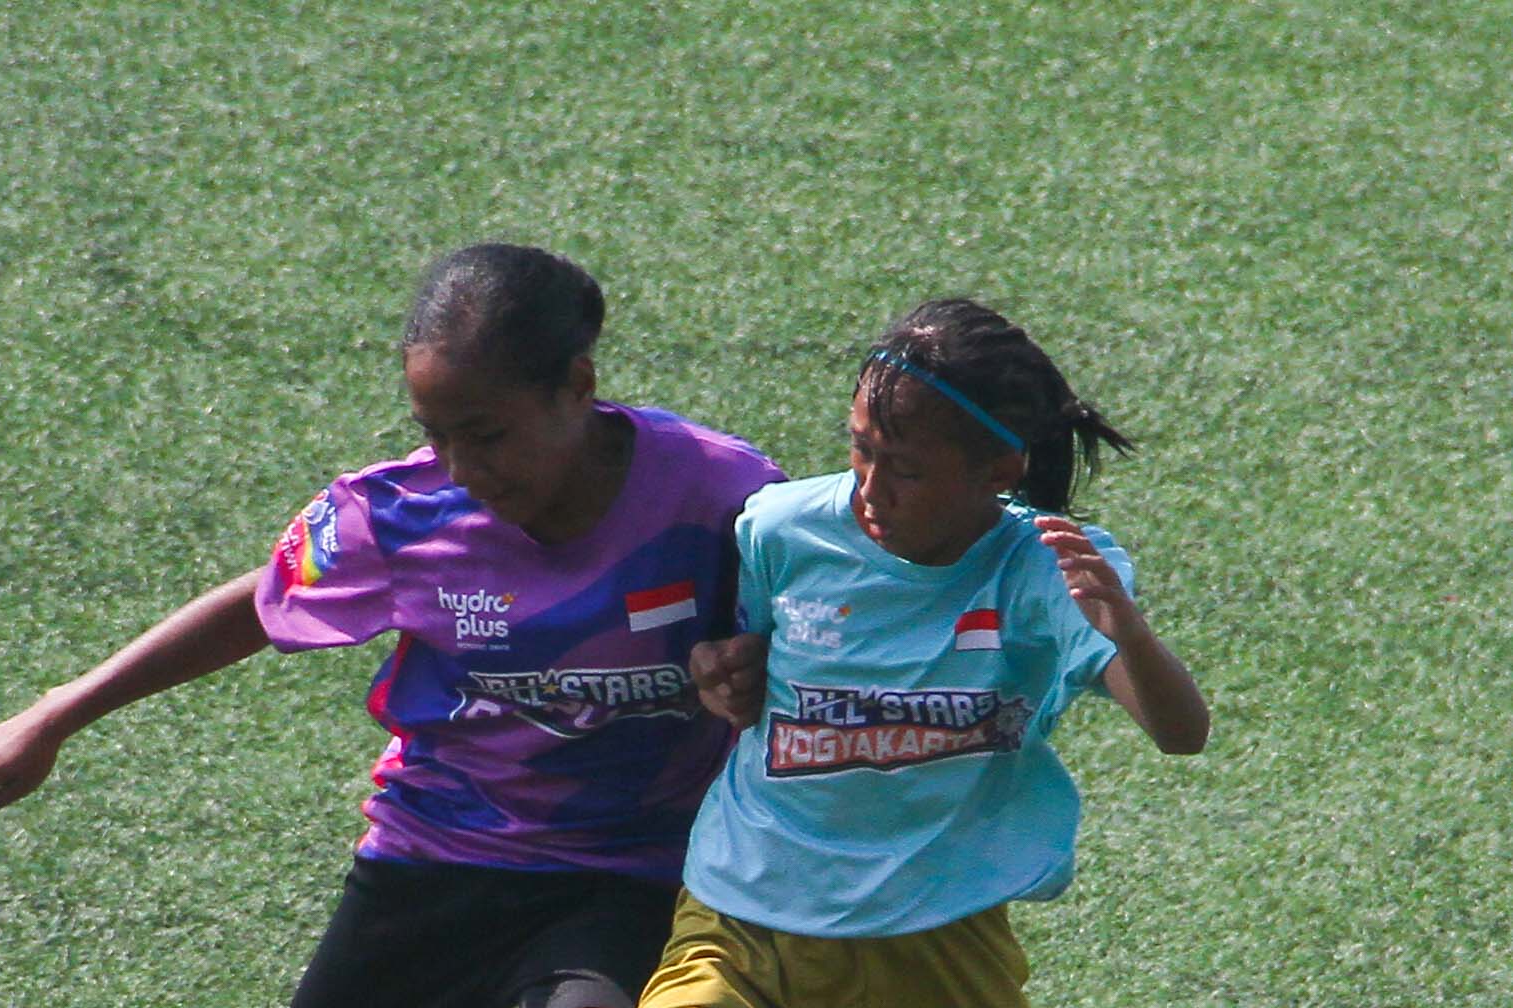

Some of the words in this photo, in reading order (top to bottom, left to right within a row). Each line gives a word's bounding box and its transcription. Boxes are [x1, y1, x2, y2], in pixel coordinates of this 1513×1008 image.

[437, 586, 512, 617] hydro
[455, 614, 509, 639] plus
[559, 669, 681, 706] STARS
[881, 692, 995, 729] STARS
[775, 723, 988, 766] YOGYAKARTA
